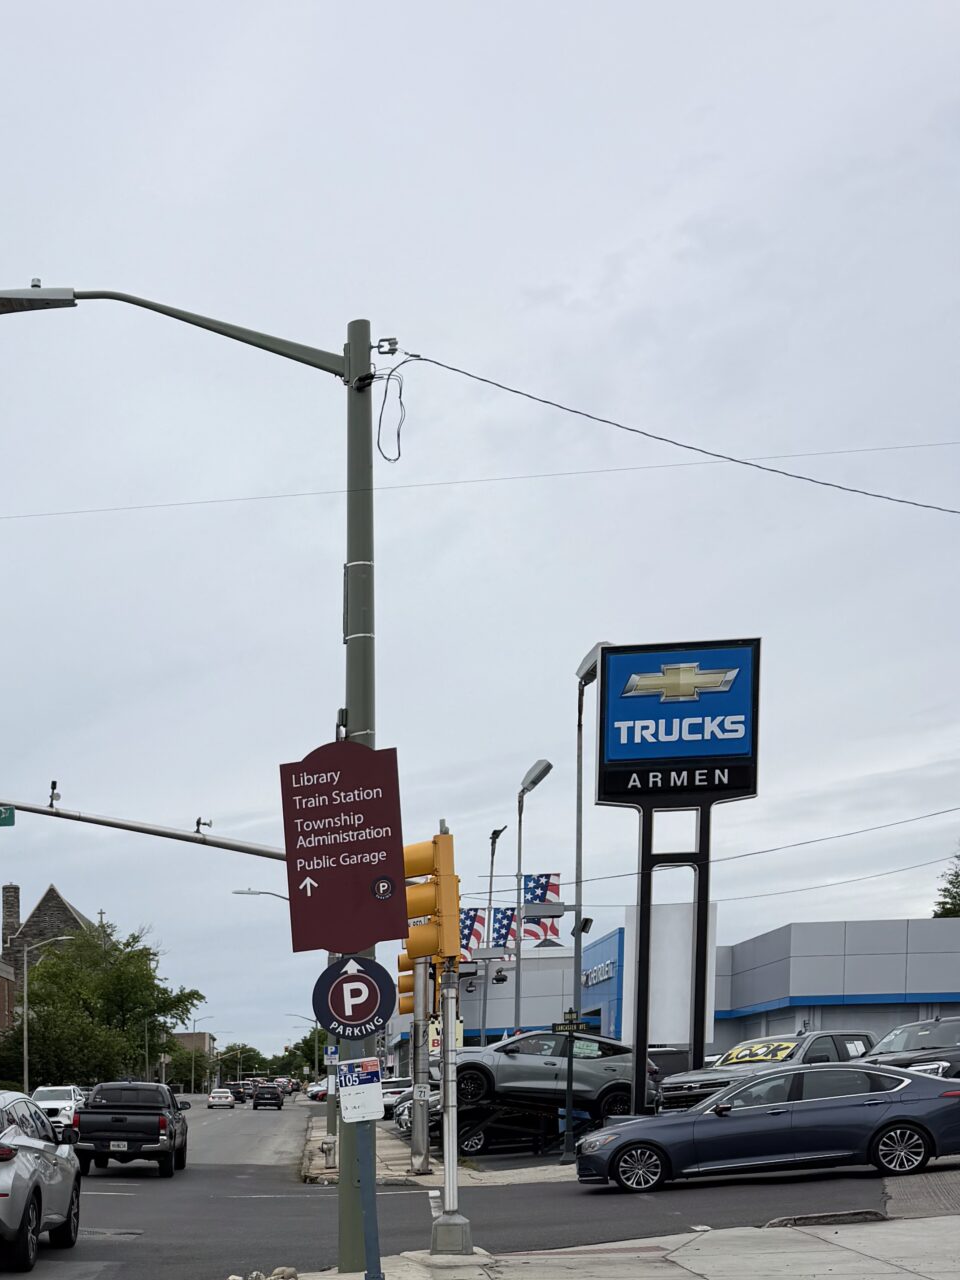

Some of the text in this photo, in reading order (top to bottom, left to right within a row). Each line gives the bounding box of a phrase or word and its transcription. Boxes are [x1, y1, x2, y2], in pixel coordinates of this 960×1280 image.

[614, 715, 746, 744] TRUCKS
[292, 771, 340, 787] Library
[627, 769, 729, 788] ARMEN
[293, 788, 382, 809] Train Station
[294, 812, 364, 832] Township
[297, 826, 392, 848] Administration
[297, 850, 387, 871] Public Garage
[380, 882, 388, 894] P
[343, 982, 369, 1016] P
[329, 1016, 384, 1036] PARKING
[340, 1073, 360, 1087] 105
